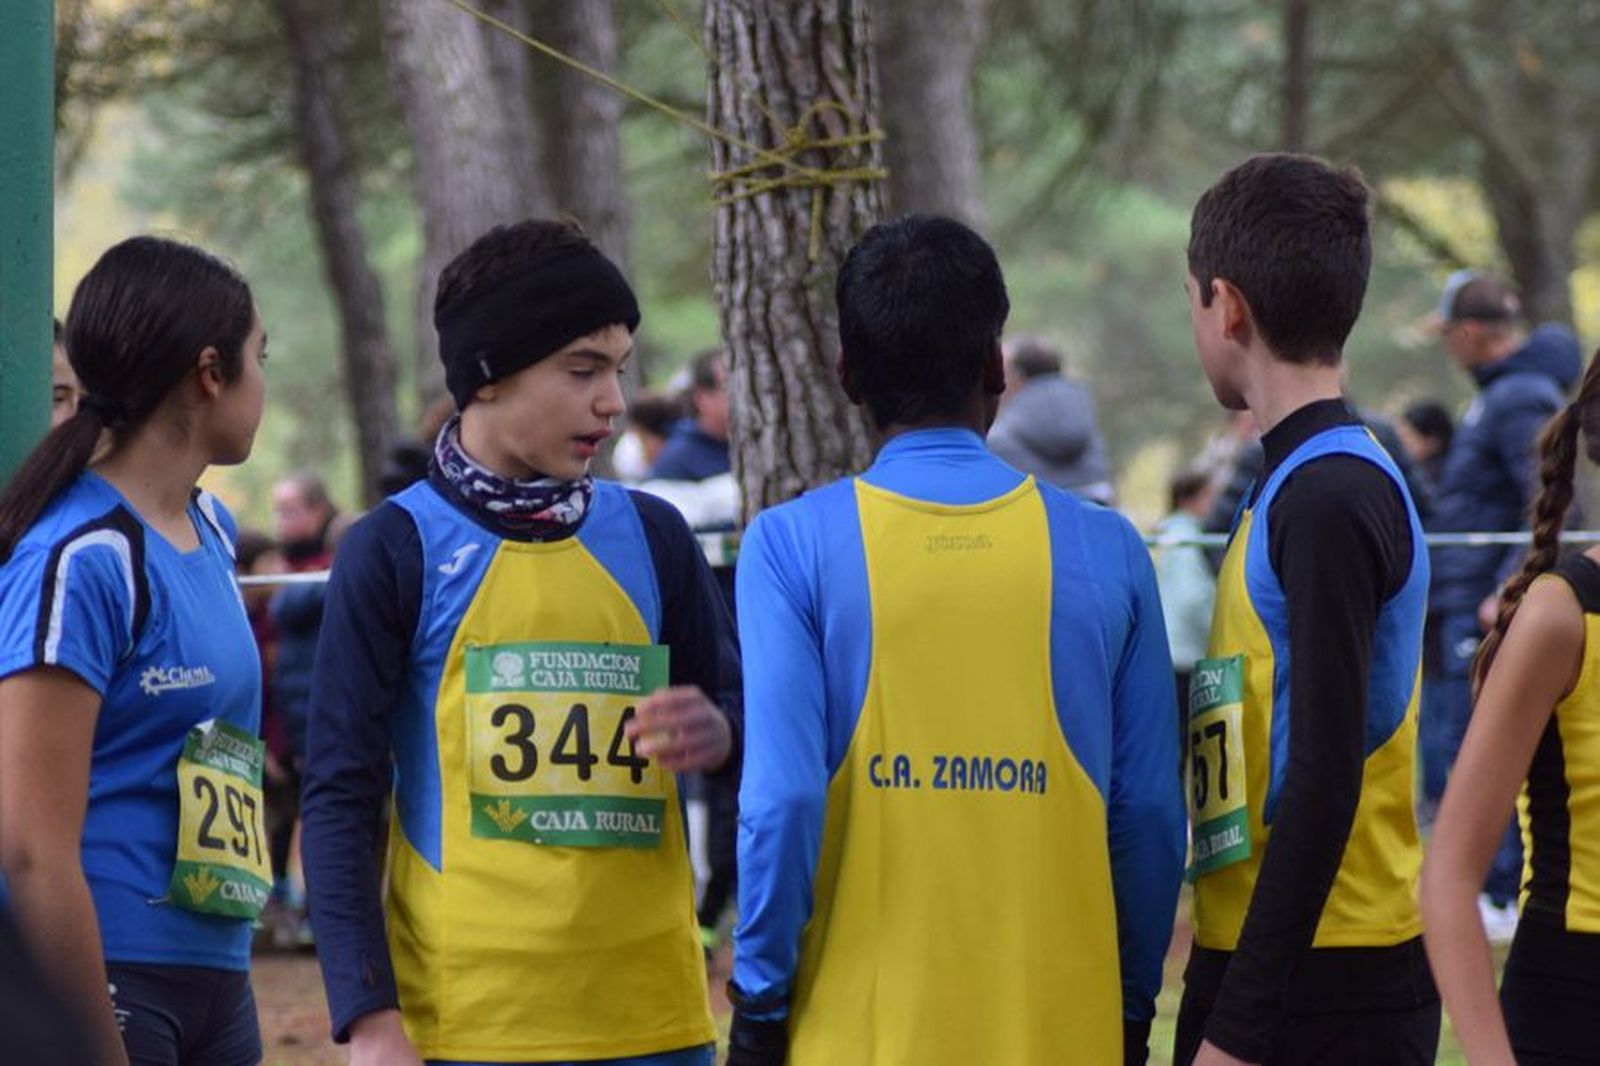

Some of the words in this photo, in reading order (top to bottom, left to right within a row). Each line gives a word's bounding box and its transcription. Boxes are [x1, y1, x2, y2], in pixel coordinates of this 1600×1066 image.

[530, 652, 641, 672] FUNDACION
[530, 671, 577, 688] CAJA
[583, 671, 642, 691] RURAL
[490, 703, 649, 785] 344
[869, 754, 920, 788] C.A.
[932, 755, 1046, 795] ZAMORA
[193, 775, 263, 866] 297
[529, 810, 588, 831] CAJA
[594, 811, 661, 834] RURAL
